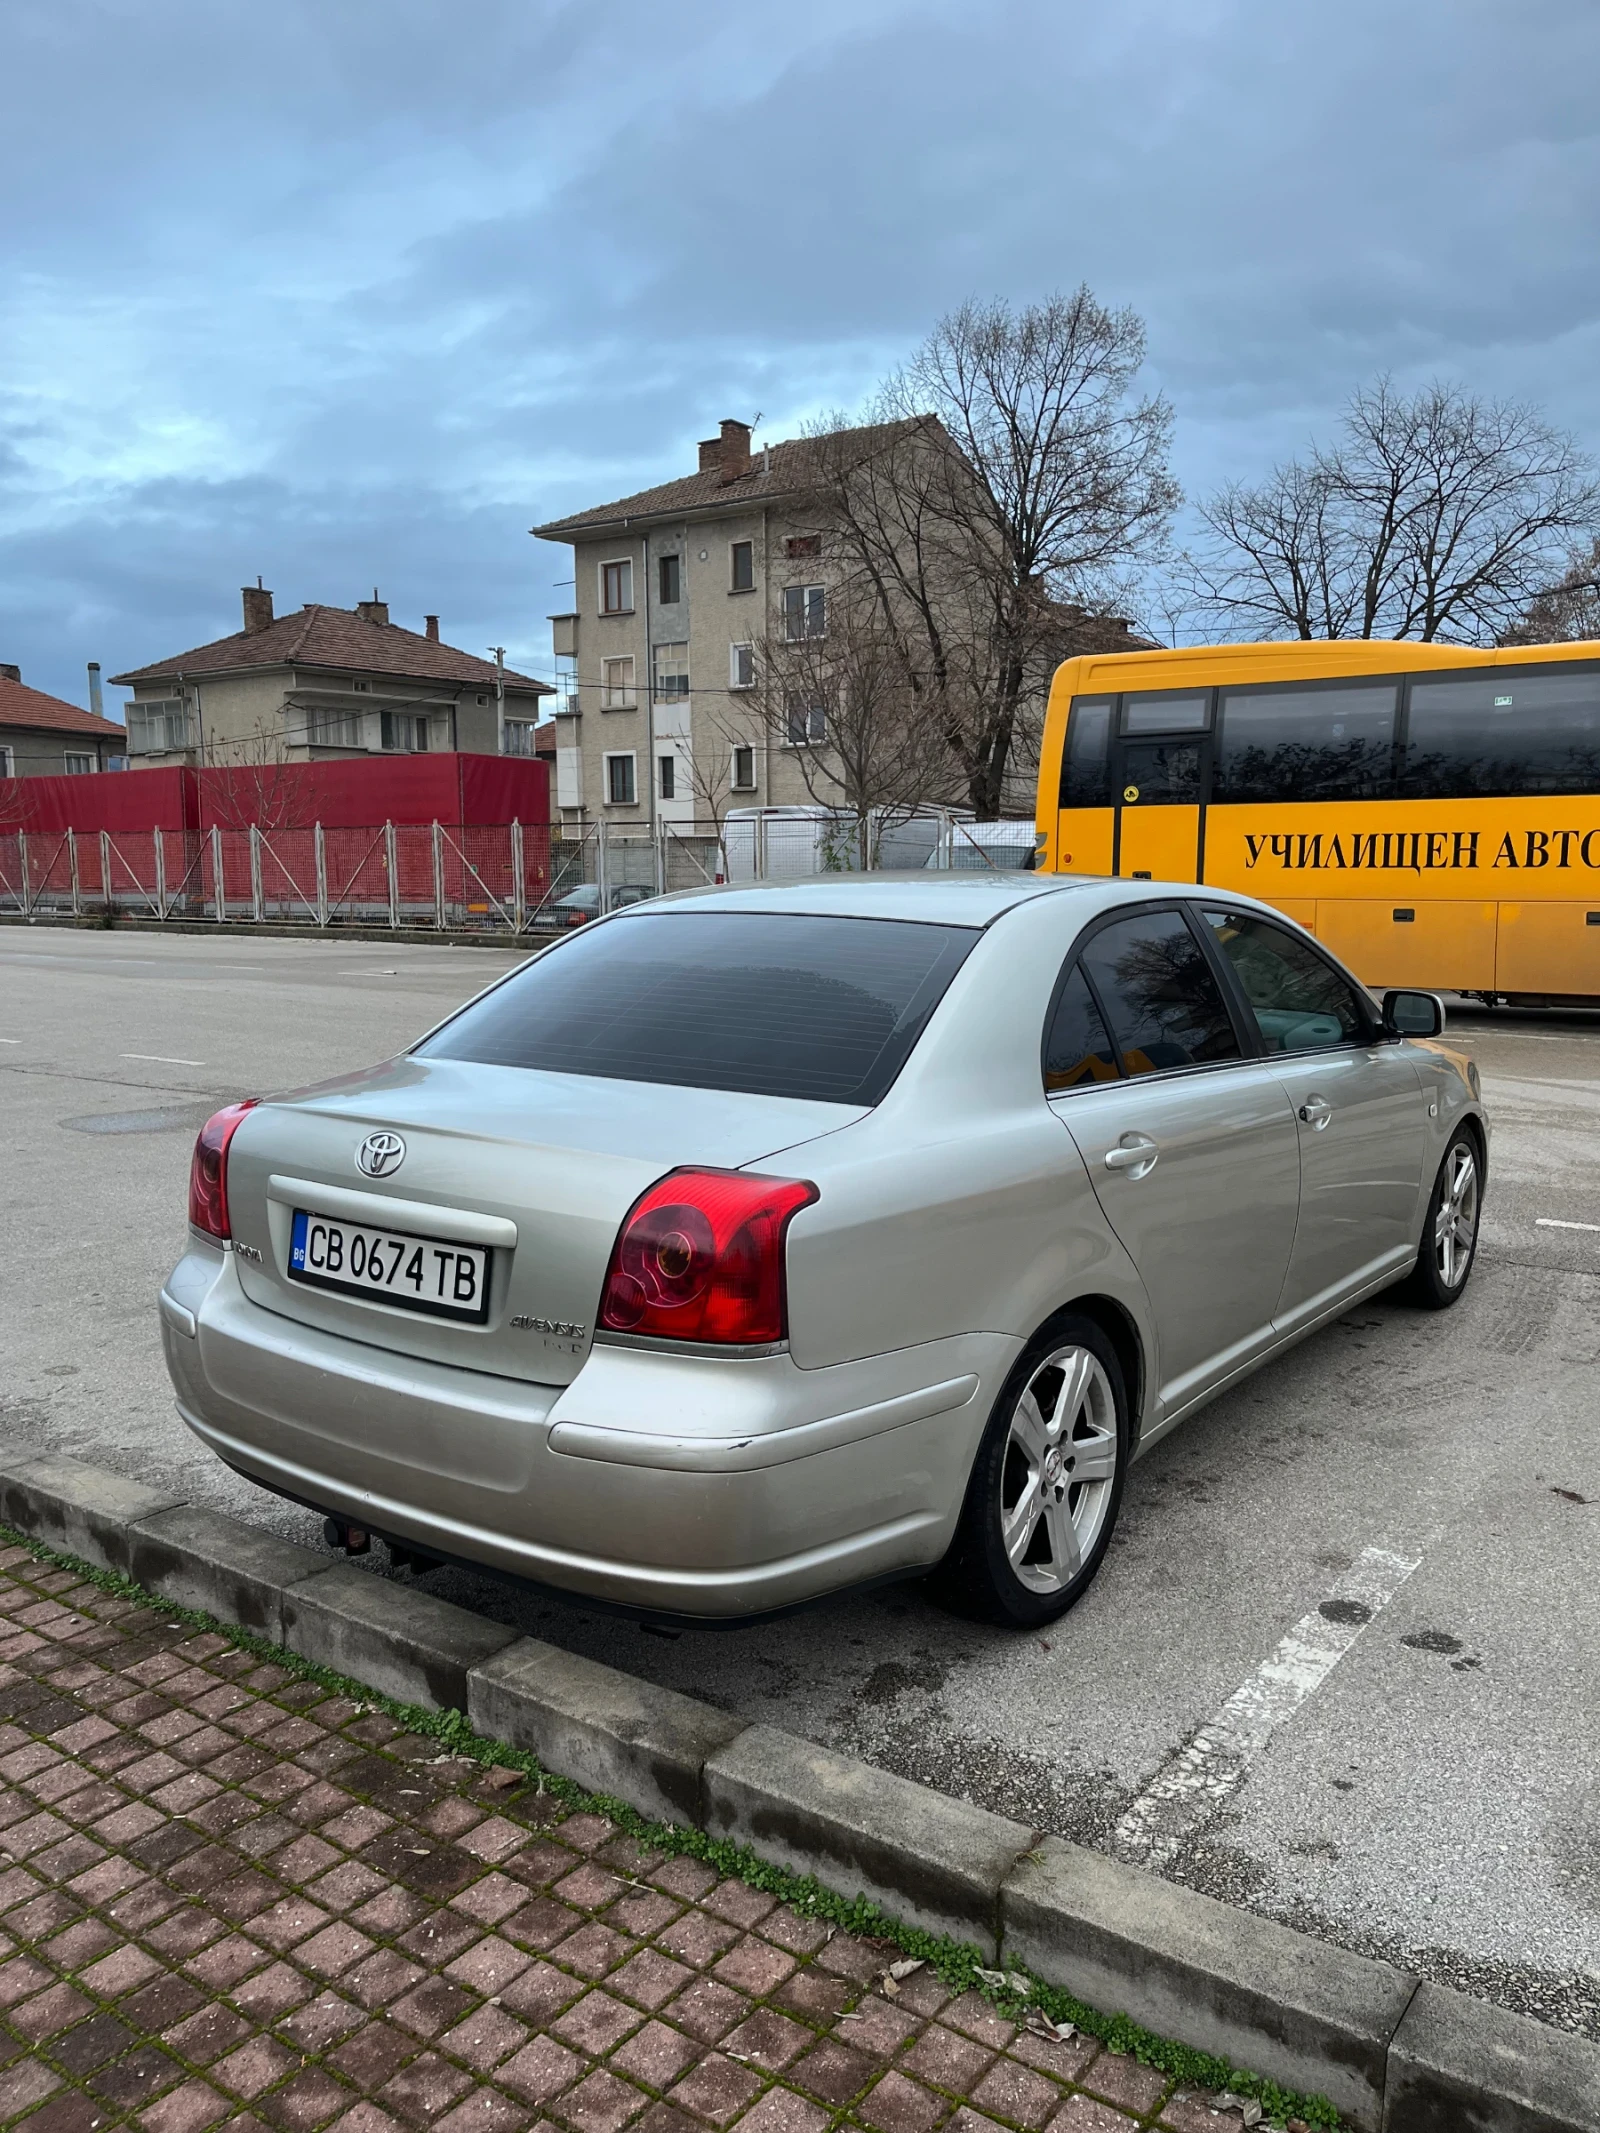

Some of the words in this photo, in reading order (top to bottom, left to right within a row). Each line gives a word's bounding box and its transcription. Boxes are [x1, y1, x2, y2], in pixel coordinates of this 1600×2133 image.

[1244, 831, 1482, 877] УЧИЛИЩЕН
[294, 1247, 305, 1261] BG
[350, 1234, 424, 1292] 0674
[509, 1315, 585, 1338] AVENSIS
